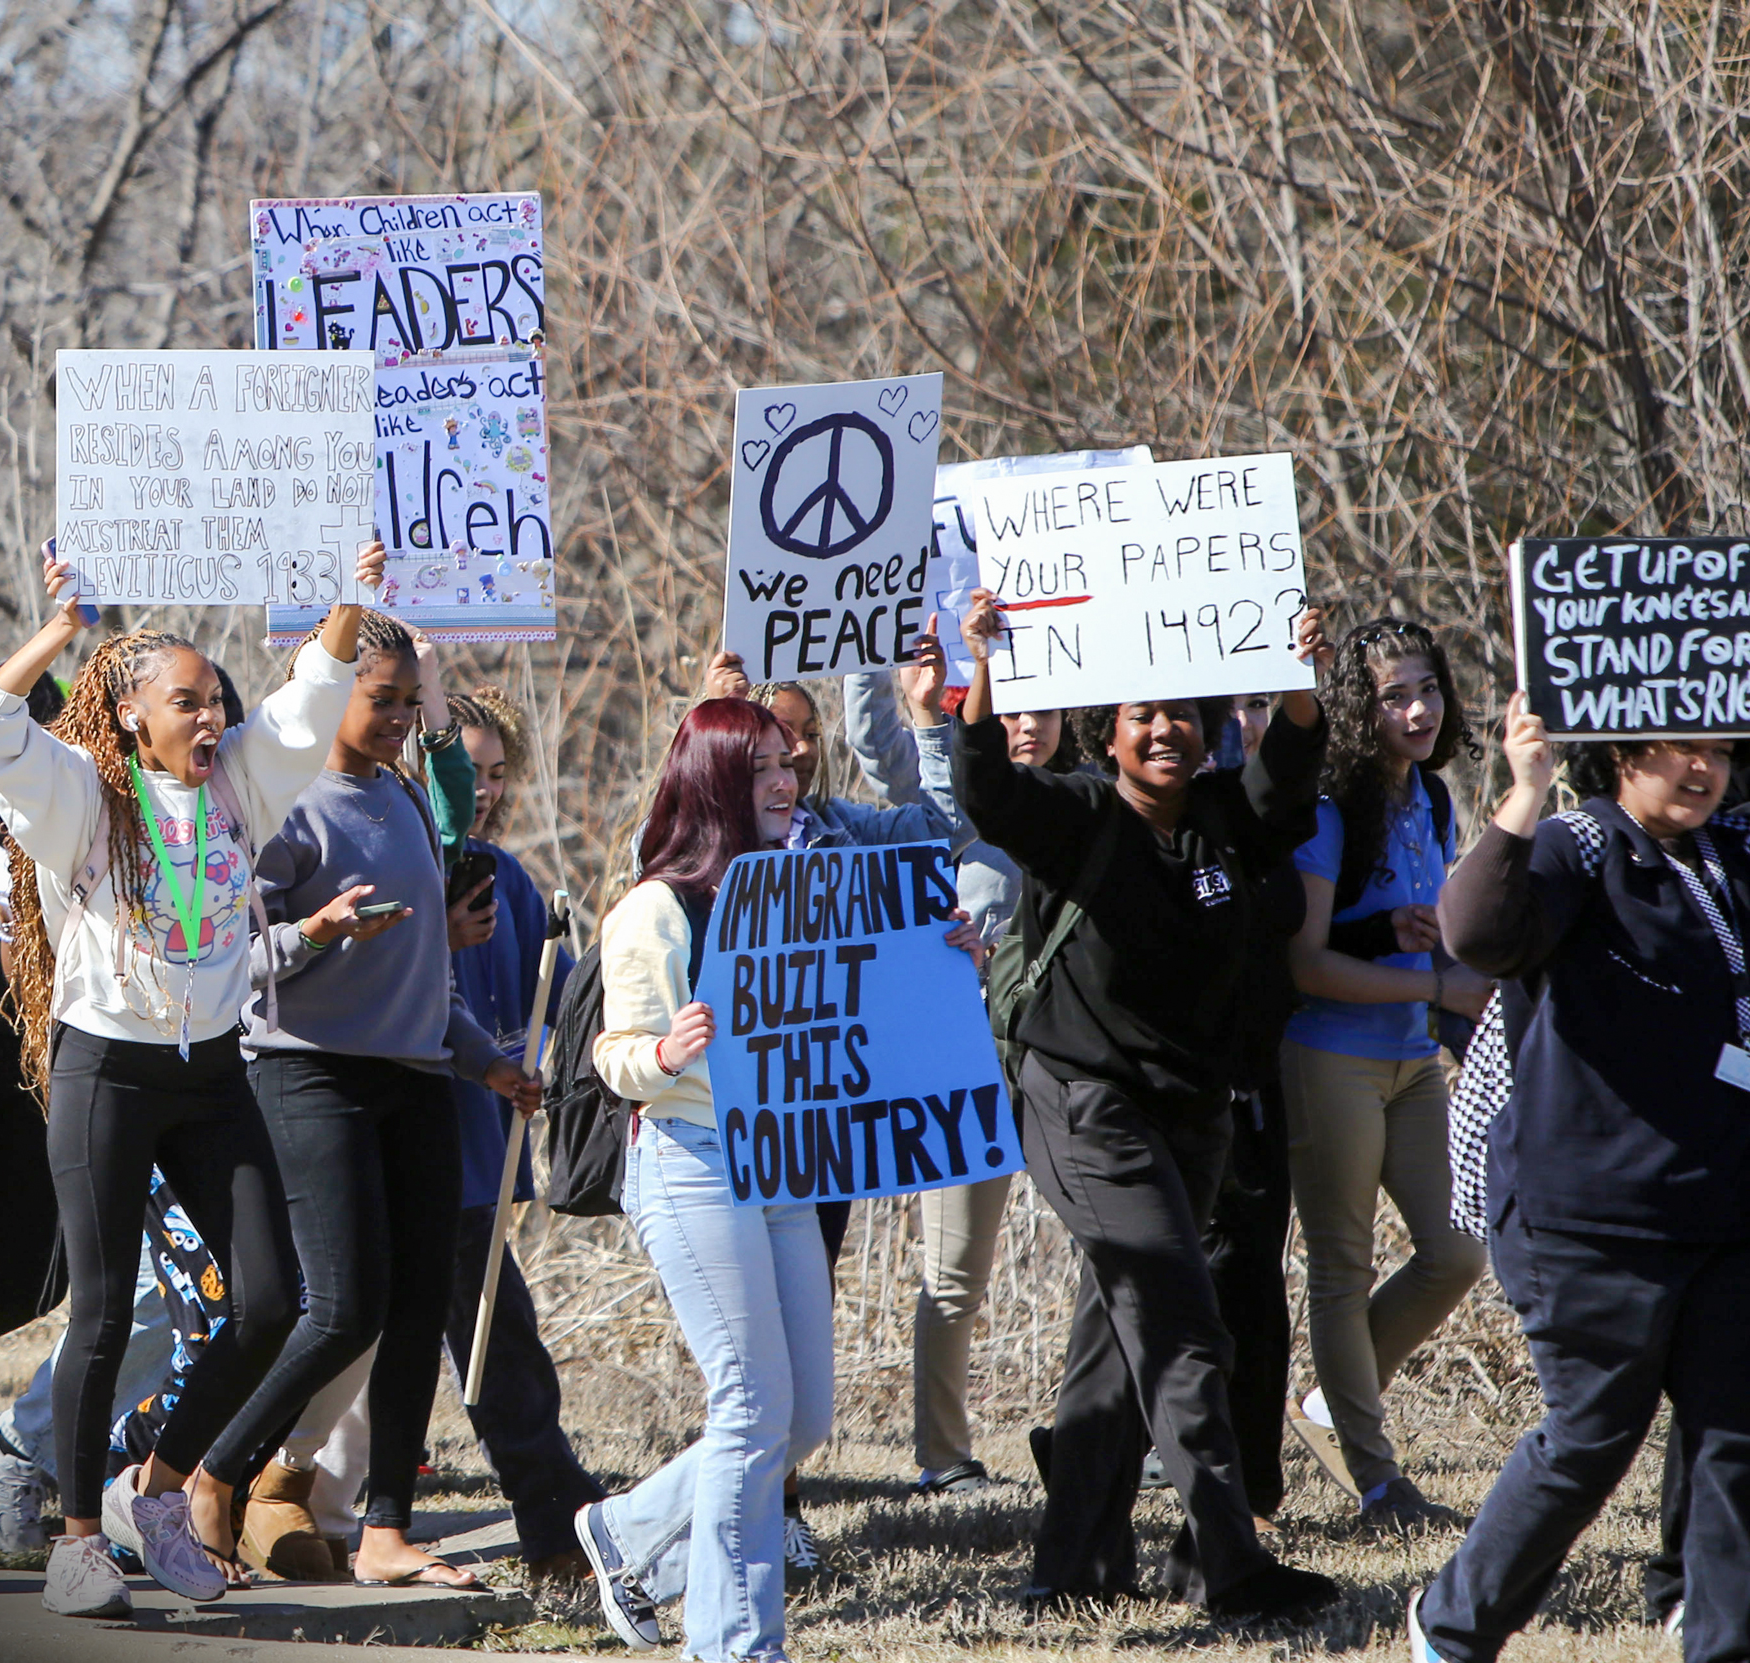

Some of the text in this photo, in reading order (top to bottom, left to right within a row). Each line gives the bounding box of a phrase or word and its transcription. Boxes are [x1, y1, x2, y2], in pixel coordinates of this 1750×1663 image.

[268, 200, 521, 246] When Children act
[384, 236, 432, 264] like
[65, 364, 374, 413] WHEN A FOREIGNER
[374, 361, 545, 408] eaders act
[69, 423, 375, 473] RESIDES AMONG YOU
[374, 414, 423, 438] like
[68, 473, 375, 510] IN YOUR LAND DO NOT
[385, 439, 553, 559] ldren
[984, 480, 1131, 541] WHERE
[1156, 467, 1262, 517] WERE
[58, 516, 269, 553] MISTREAT THEM
[835, 546, 928, 601] need
[991, 532, 1296, 598] YOUR PAPERS
[764, 597, 925, 680] PEACE
[995, 623, 1082, 682] IN
[1145, 588, 1307, 666] 1492?
[1543, 632, 1674, 687] STAND
[1560, 676, 1707, 731] WHAT'S
[718, 845, 959, 953] IMMIGRANTS
[732, 943, 877, 1036] BUILT
[747, 1023, 871, 1106] THIS
[725, 1083, 1005, 1202] COUNTRY!
